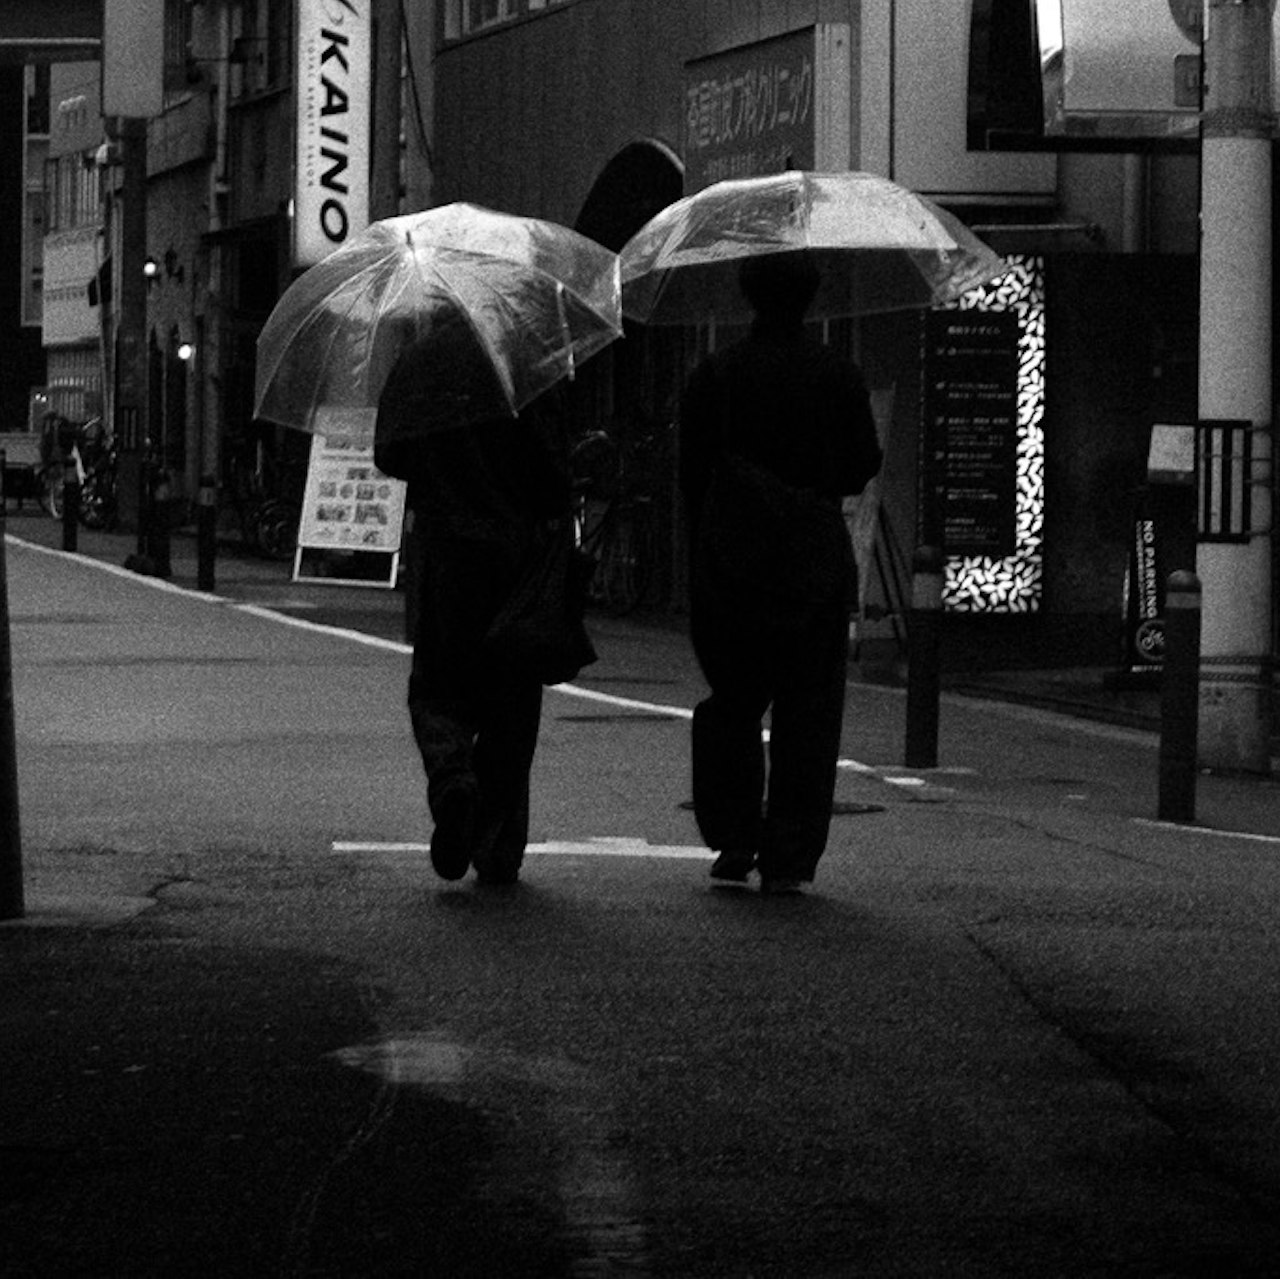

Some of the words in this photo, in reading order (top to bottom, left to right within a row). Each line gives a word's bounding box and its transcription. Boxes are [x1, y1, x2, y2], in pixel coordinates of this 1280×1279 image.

[320, 28, 349, 244] KAINO
[1143, 520, 1154, 543] NO
[1145, 547, 1158, 618] PARKING
